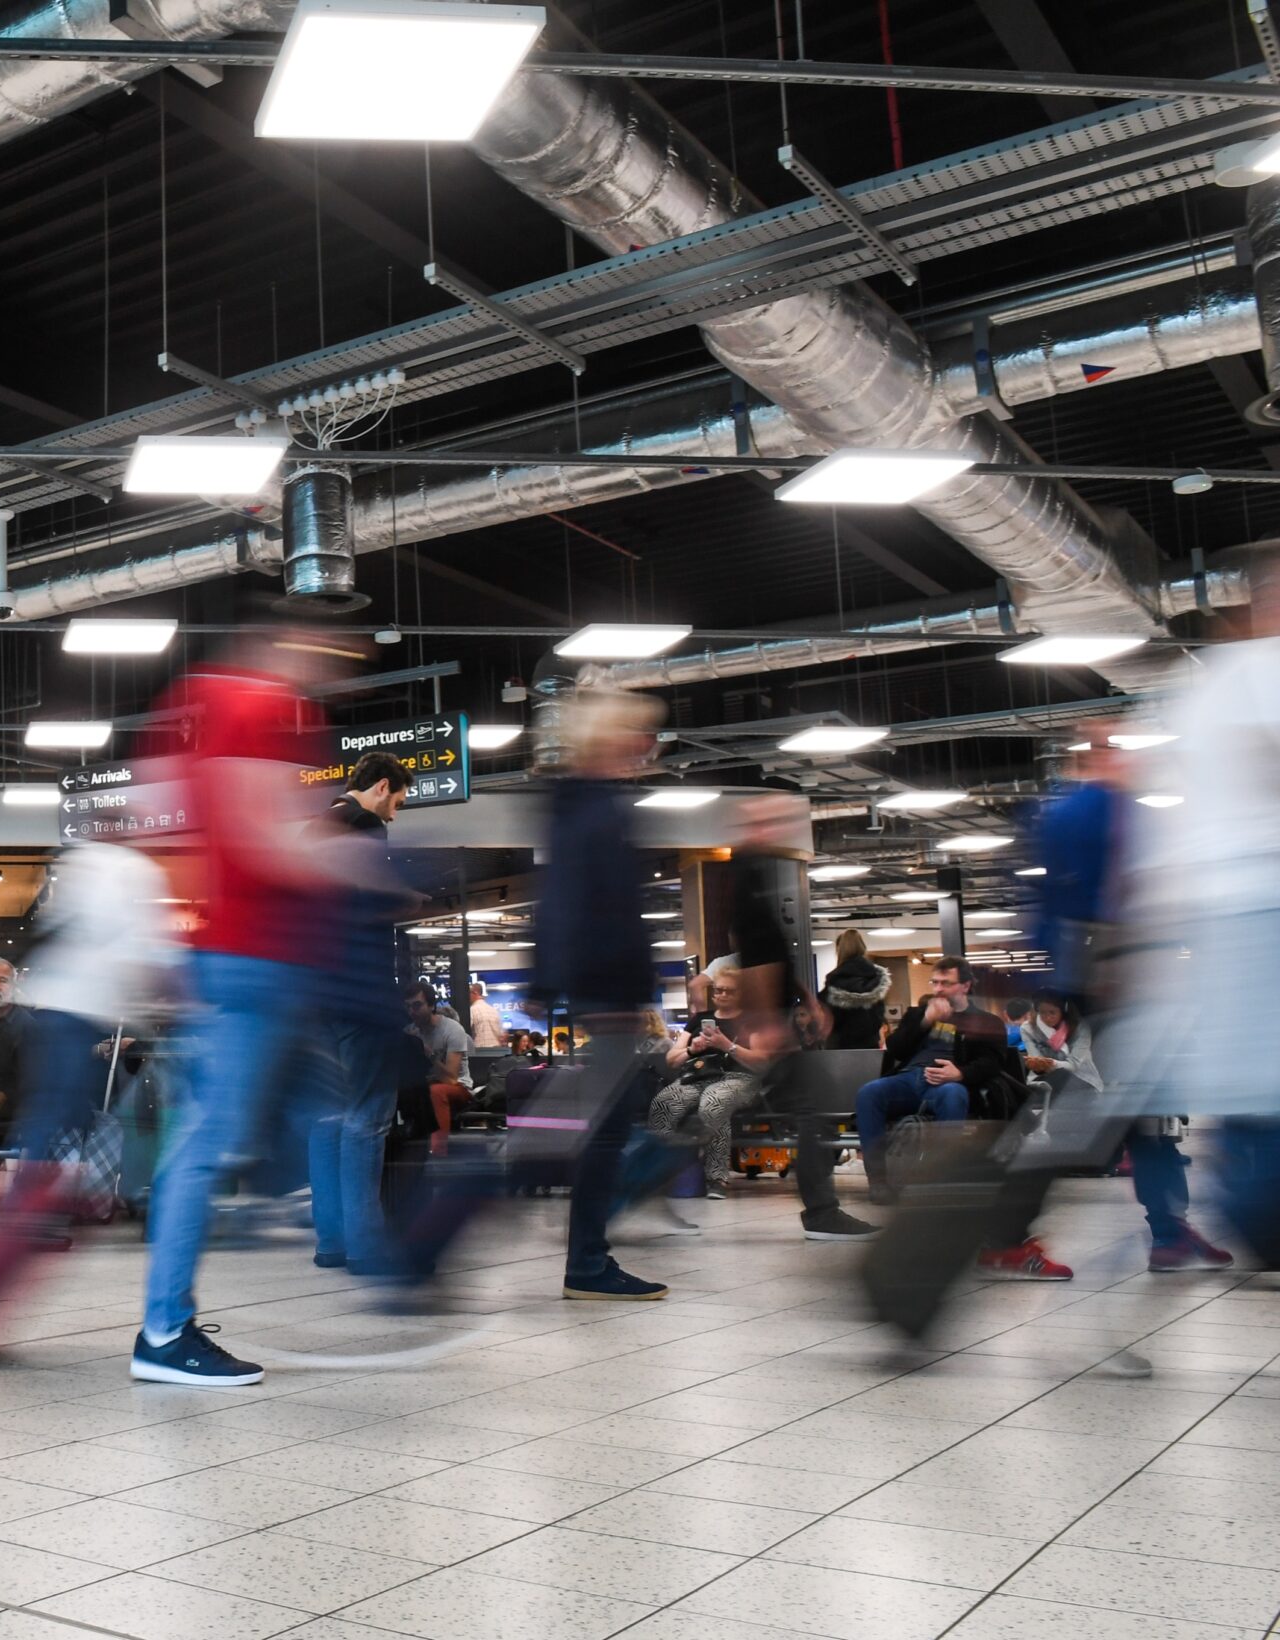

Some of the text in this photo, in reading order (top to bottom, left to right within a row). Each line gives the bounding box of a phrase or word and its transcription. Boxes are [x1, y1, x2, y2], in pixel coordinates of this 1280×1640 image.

[341, 729, 415, 751] Departures
[91, 768, 132, 785] Arrivals
[299, 764, 344, 785] Special
[92, 794, 127, 809] Toilets
[93, 818, 124, 833] Travel
